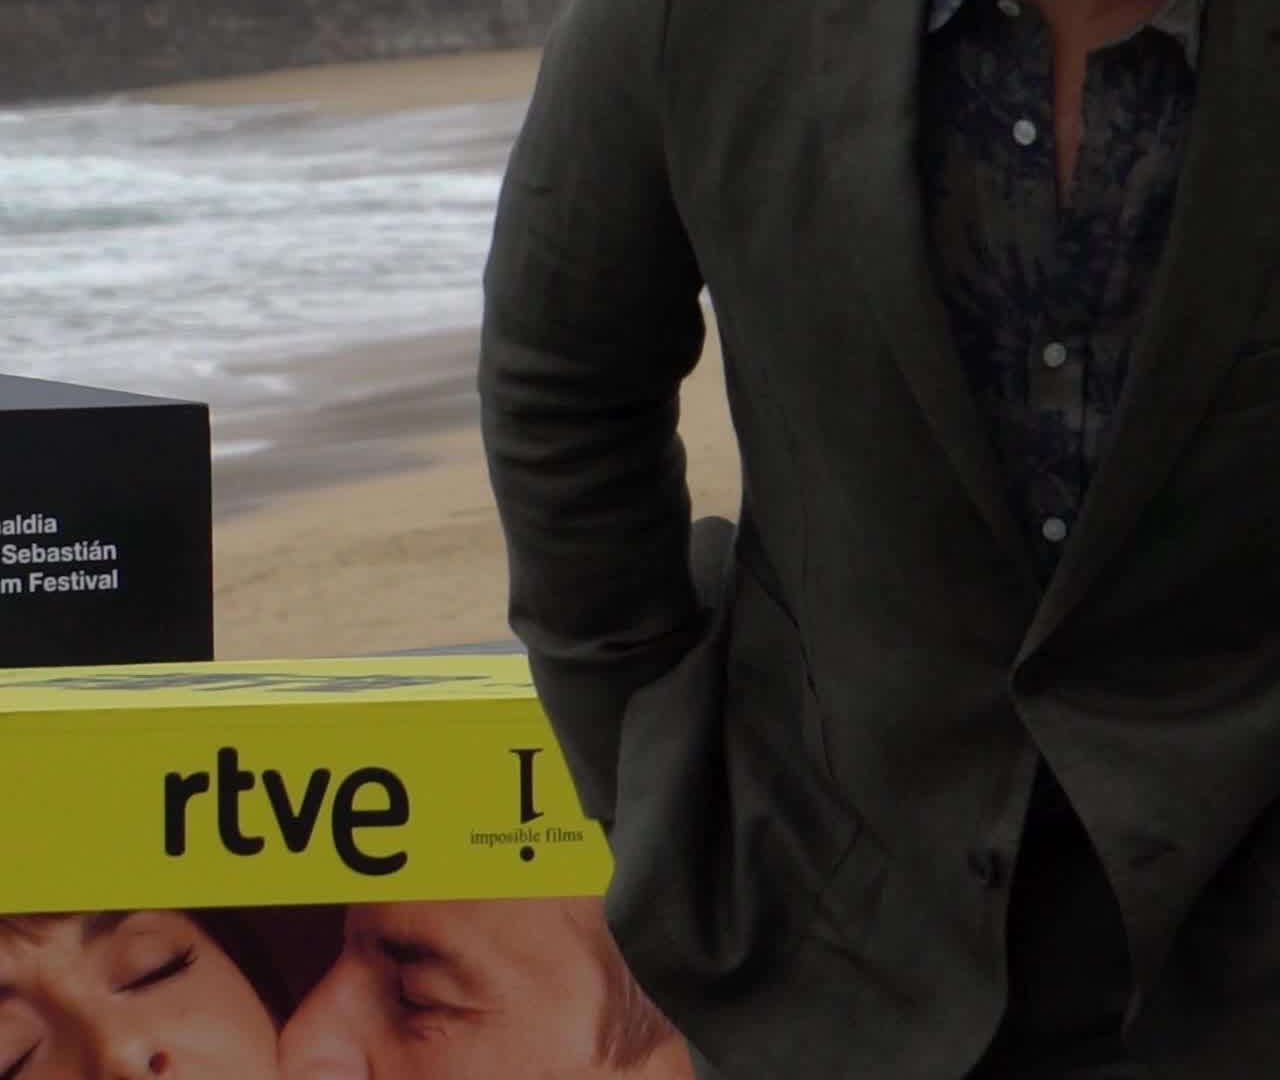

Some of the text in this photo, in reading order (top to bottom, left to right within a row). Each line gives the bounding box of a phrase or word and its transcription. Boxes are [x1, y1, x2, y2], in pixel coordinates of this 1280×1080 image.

[2, 540, 116, 564] Sebastián
[29, 568, 118, 592] Festival
[164, 746, 410, 877] rtve
[470, 827, 583, 847] imposible films
